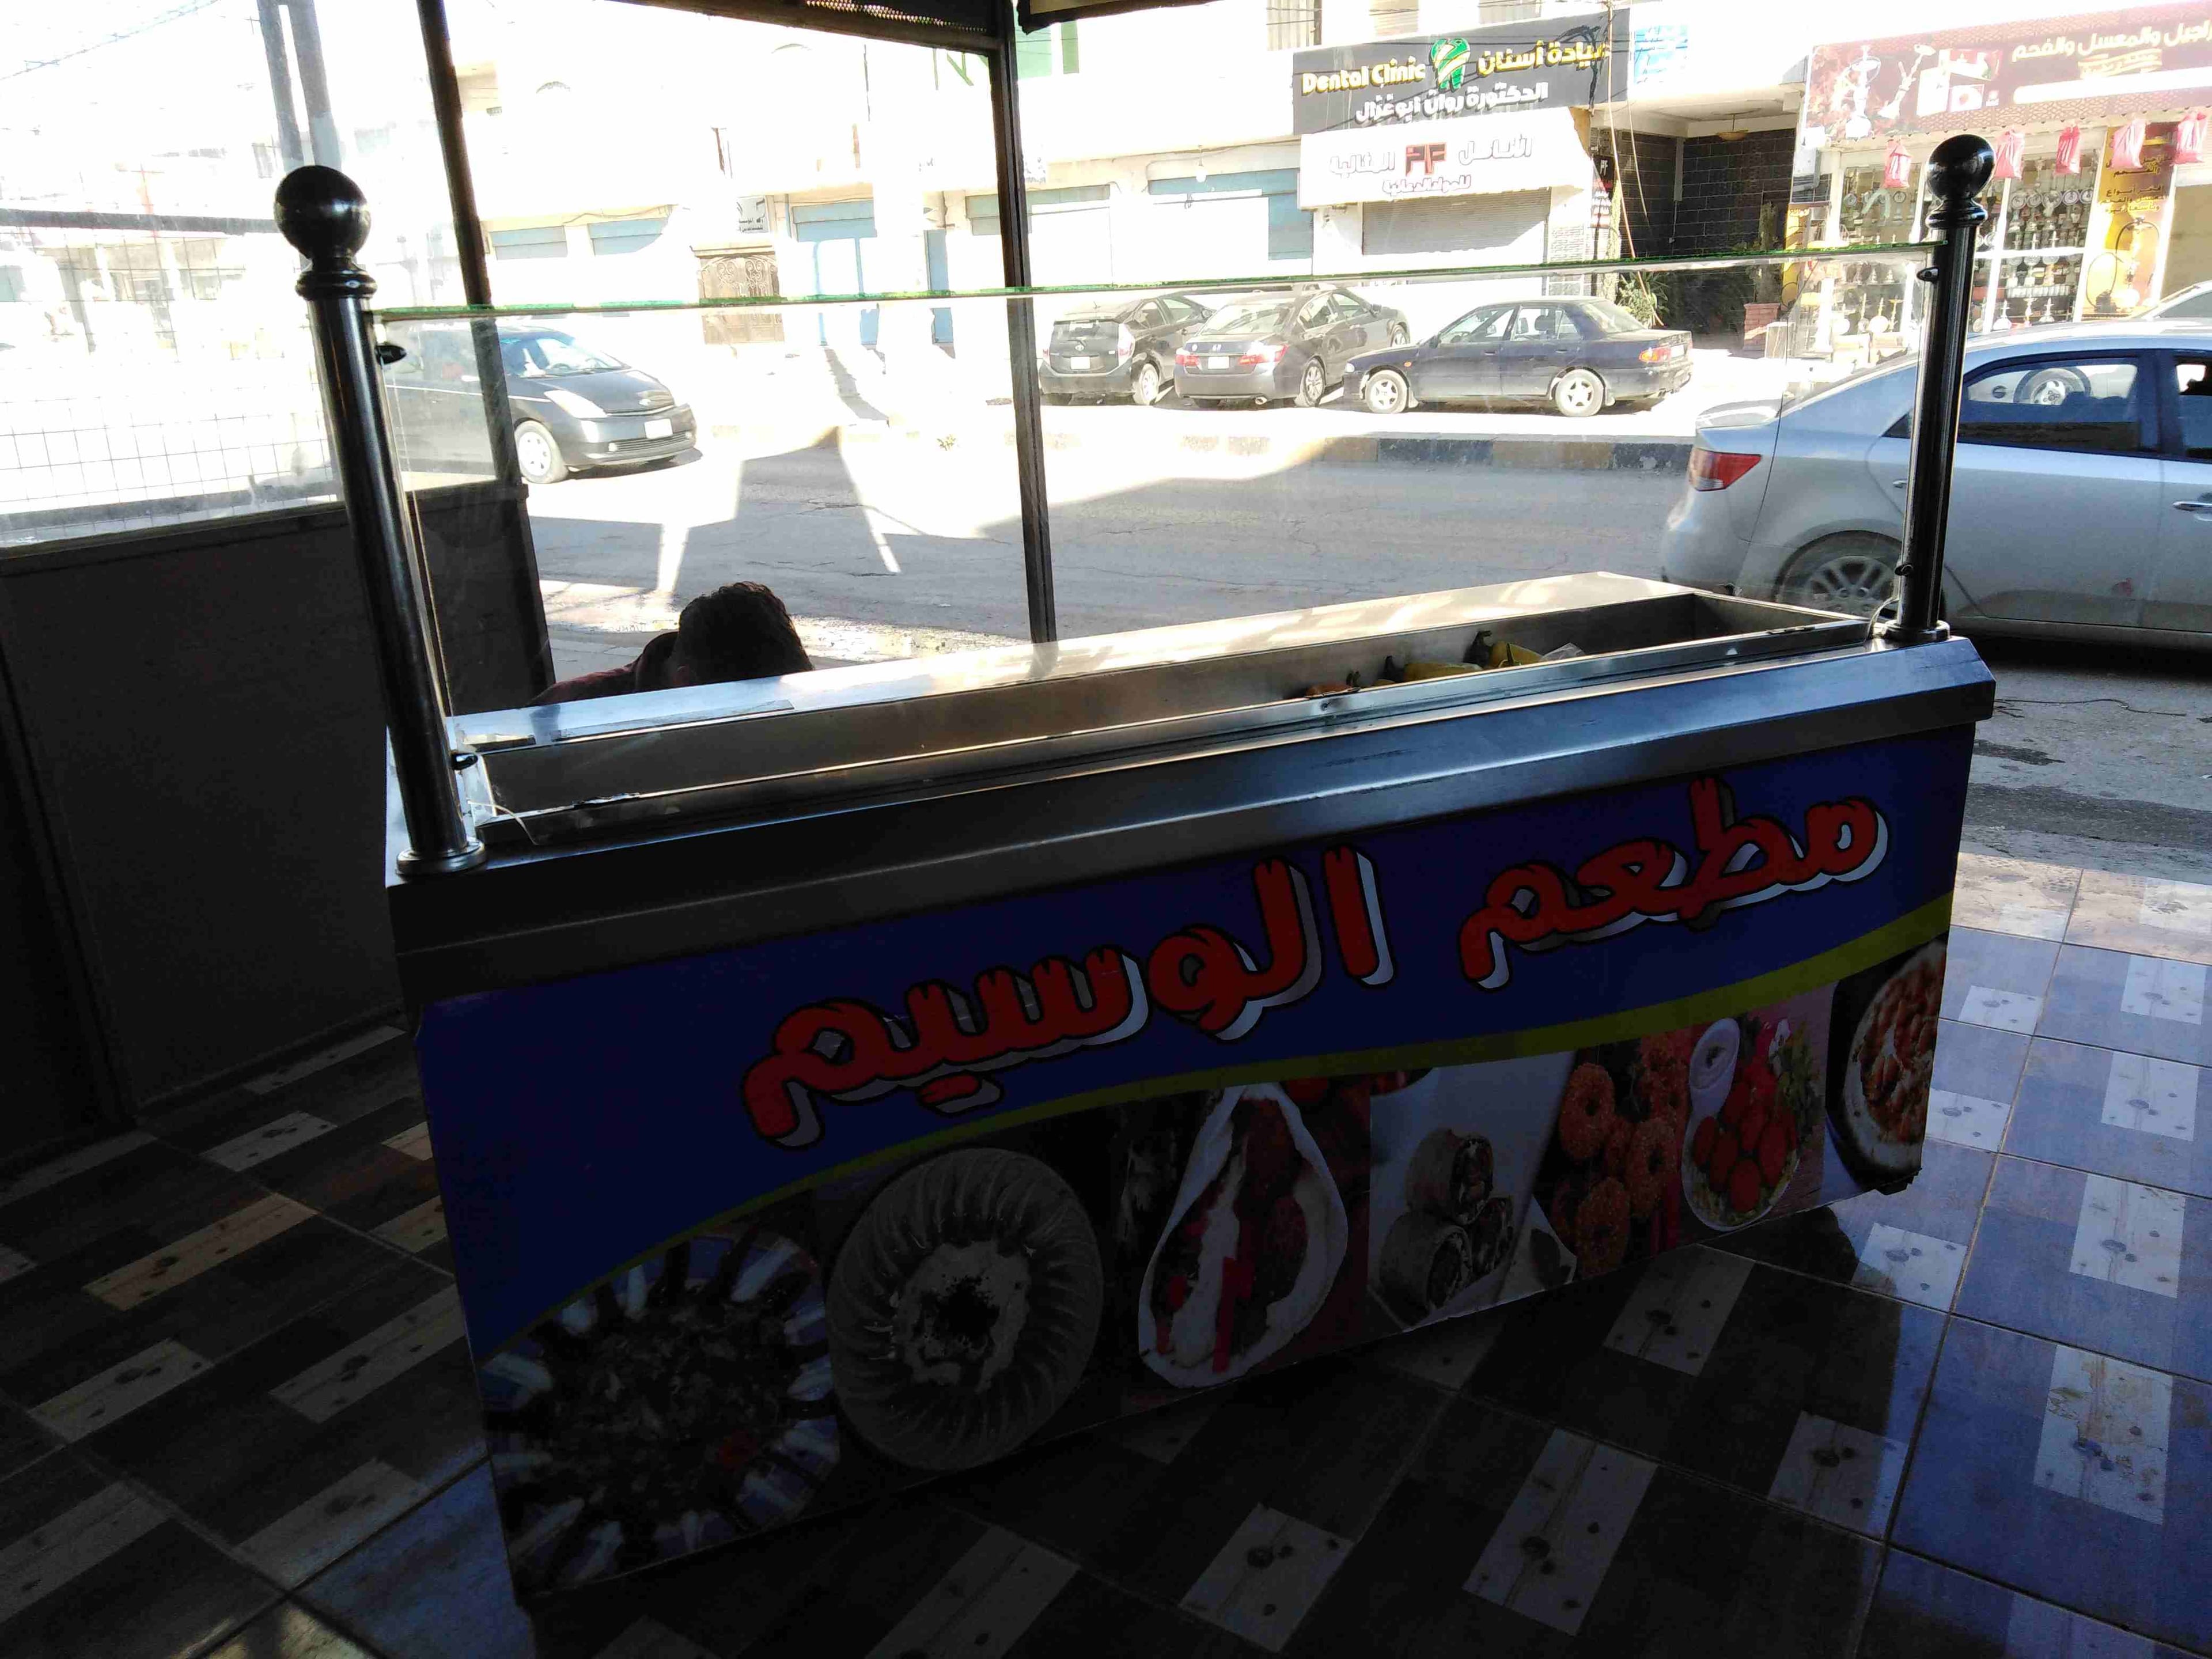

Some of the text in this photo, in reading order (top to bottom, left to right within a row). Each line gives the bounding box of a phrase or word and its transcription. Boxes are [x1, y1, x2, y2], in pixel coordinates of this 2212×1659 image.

[1477, 40, 1544, 77] أسنان
[1546, 41, 1612, 71] عيادة
[1301, 56, 1426, 96] Dental Clinic
[1466, 82, 1548, 111] الدكتورة
[741, 774, 1890, 1149] مطعم الوسيم
